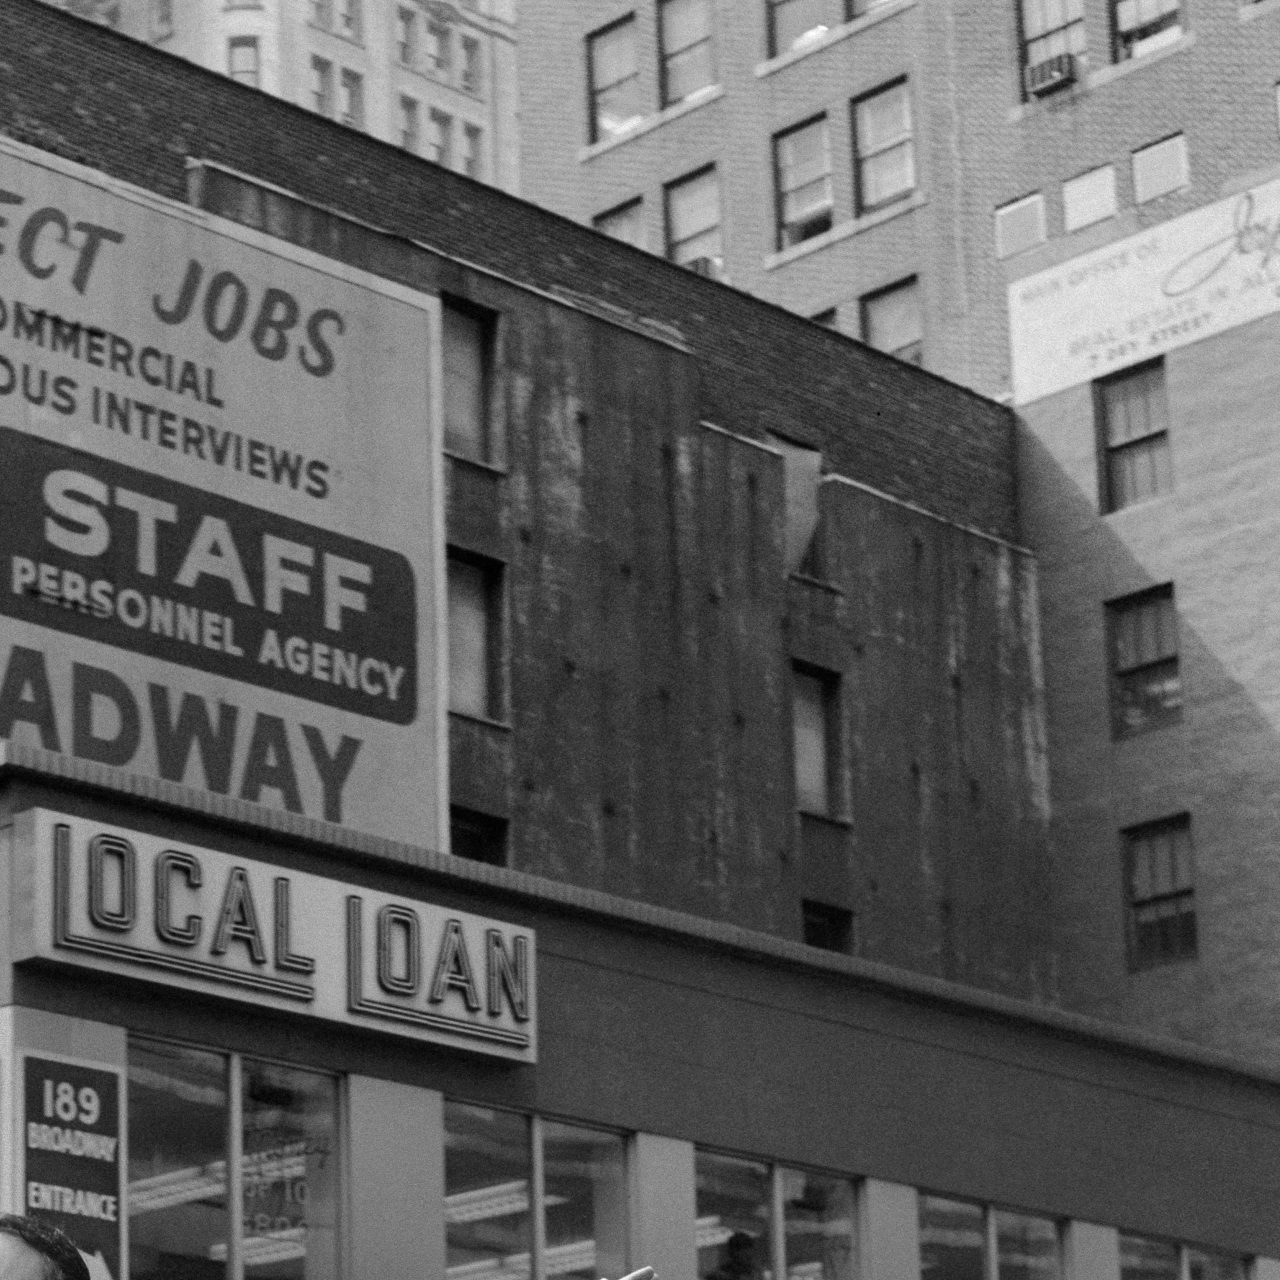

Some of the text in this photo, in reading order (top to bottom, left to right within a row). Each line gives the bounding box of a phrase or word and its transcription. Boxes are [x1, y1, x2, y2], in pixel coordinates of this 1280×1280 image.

[152, 259, 346, 378] JOBS
[91, 385, 331, 500] INTERVIEWS
[42, 469, 373, 632] STAFF
[11, 556, 406, 700] PERSONNEL AGENCY
[53, 823, 529, 1048] LOCAL LOAN
[43, 1079, 100, 1125] 189
[27, 1181, 117, 1222] ENTRANCE
